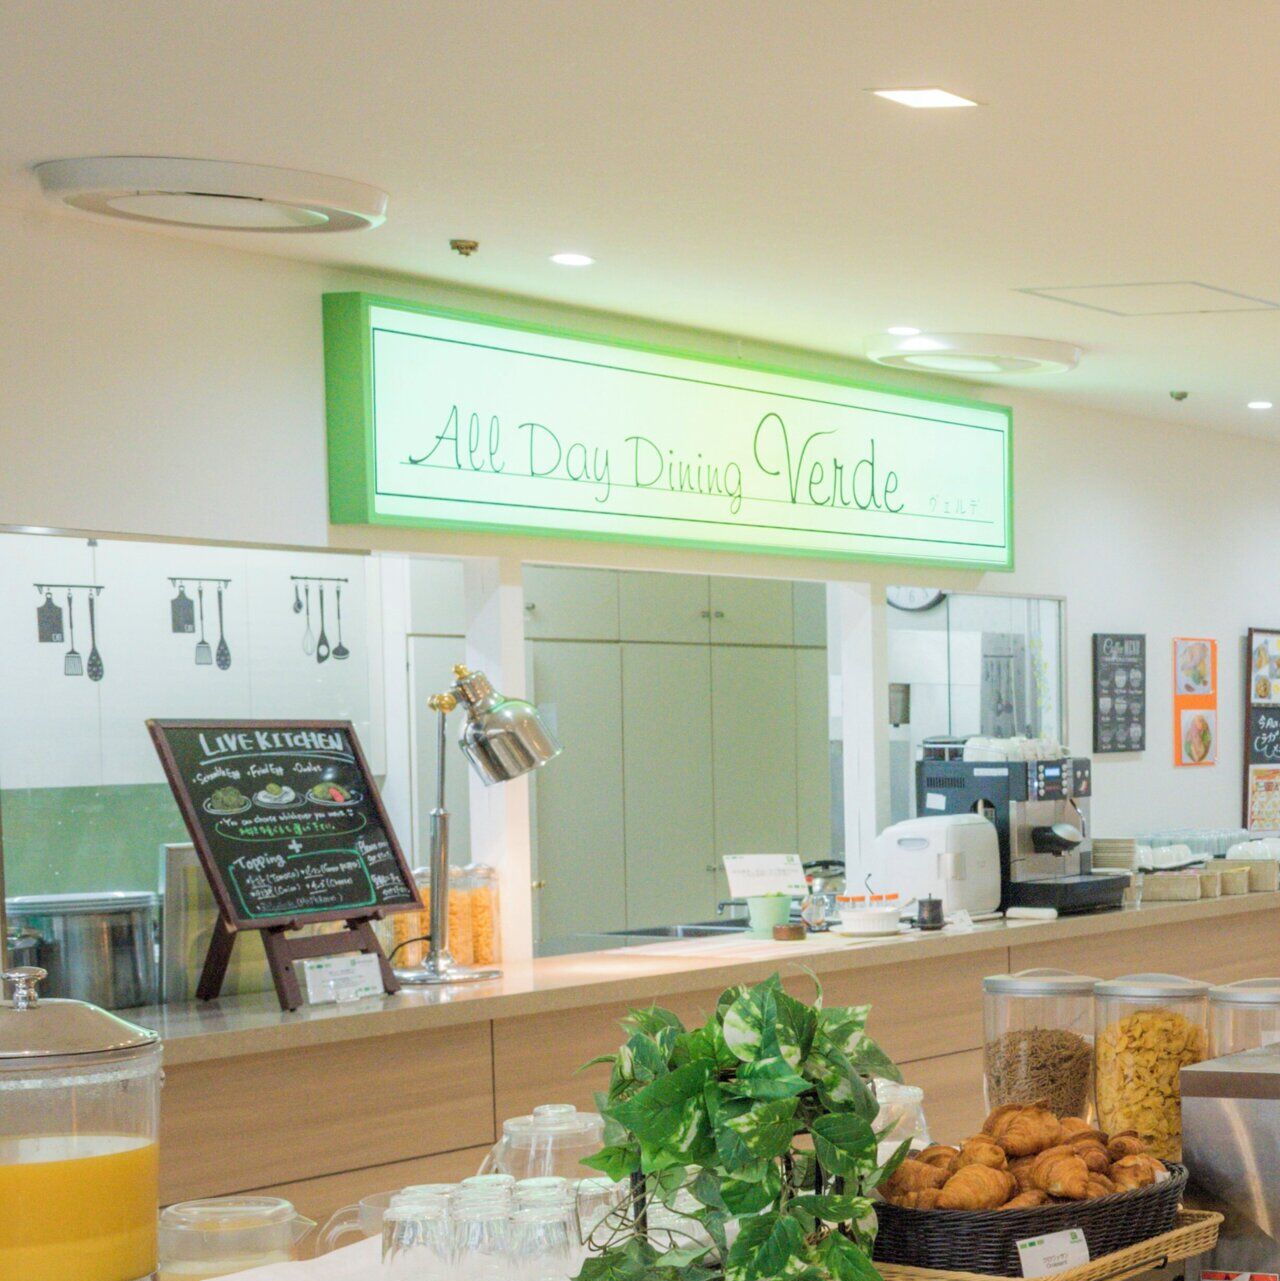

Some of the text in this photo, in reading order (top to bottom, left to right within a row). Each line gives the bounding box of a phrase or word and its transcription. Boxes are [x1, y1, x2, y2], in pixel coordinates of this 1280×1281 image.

[408, 404, 905, 514] All Day Dining Verde
[200, 731, 344, 756] LIVE KITCHEN
[234, 852, 287, 872] Topping
